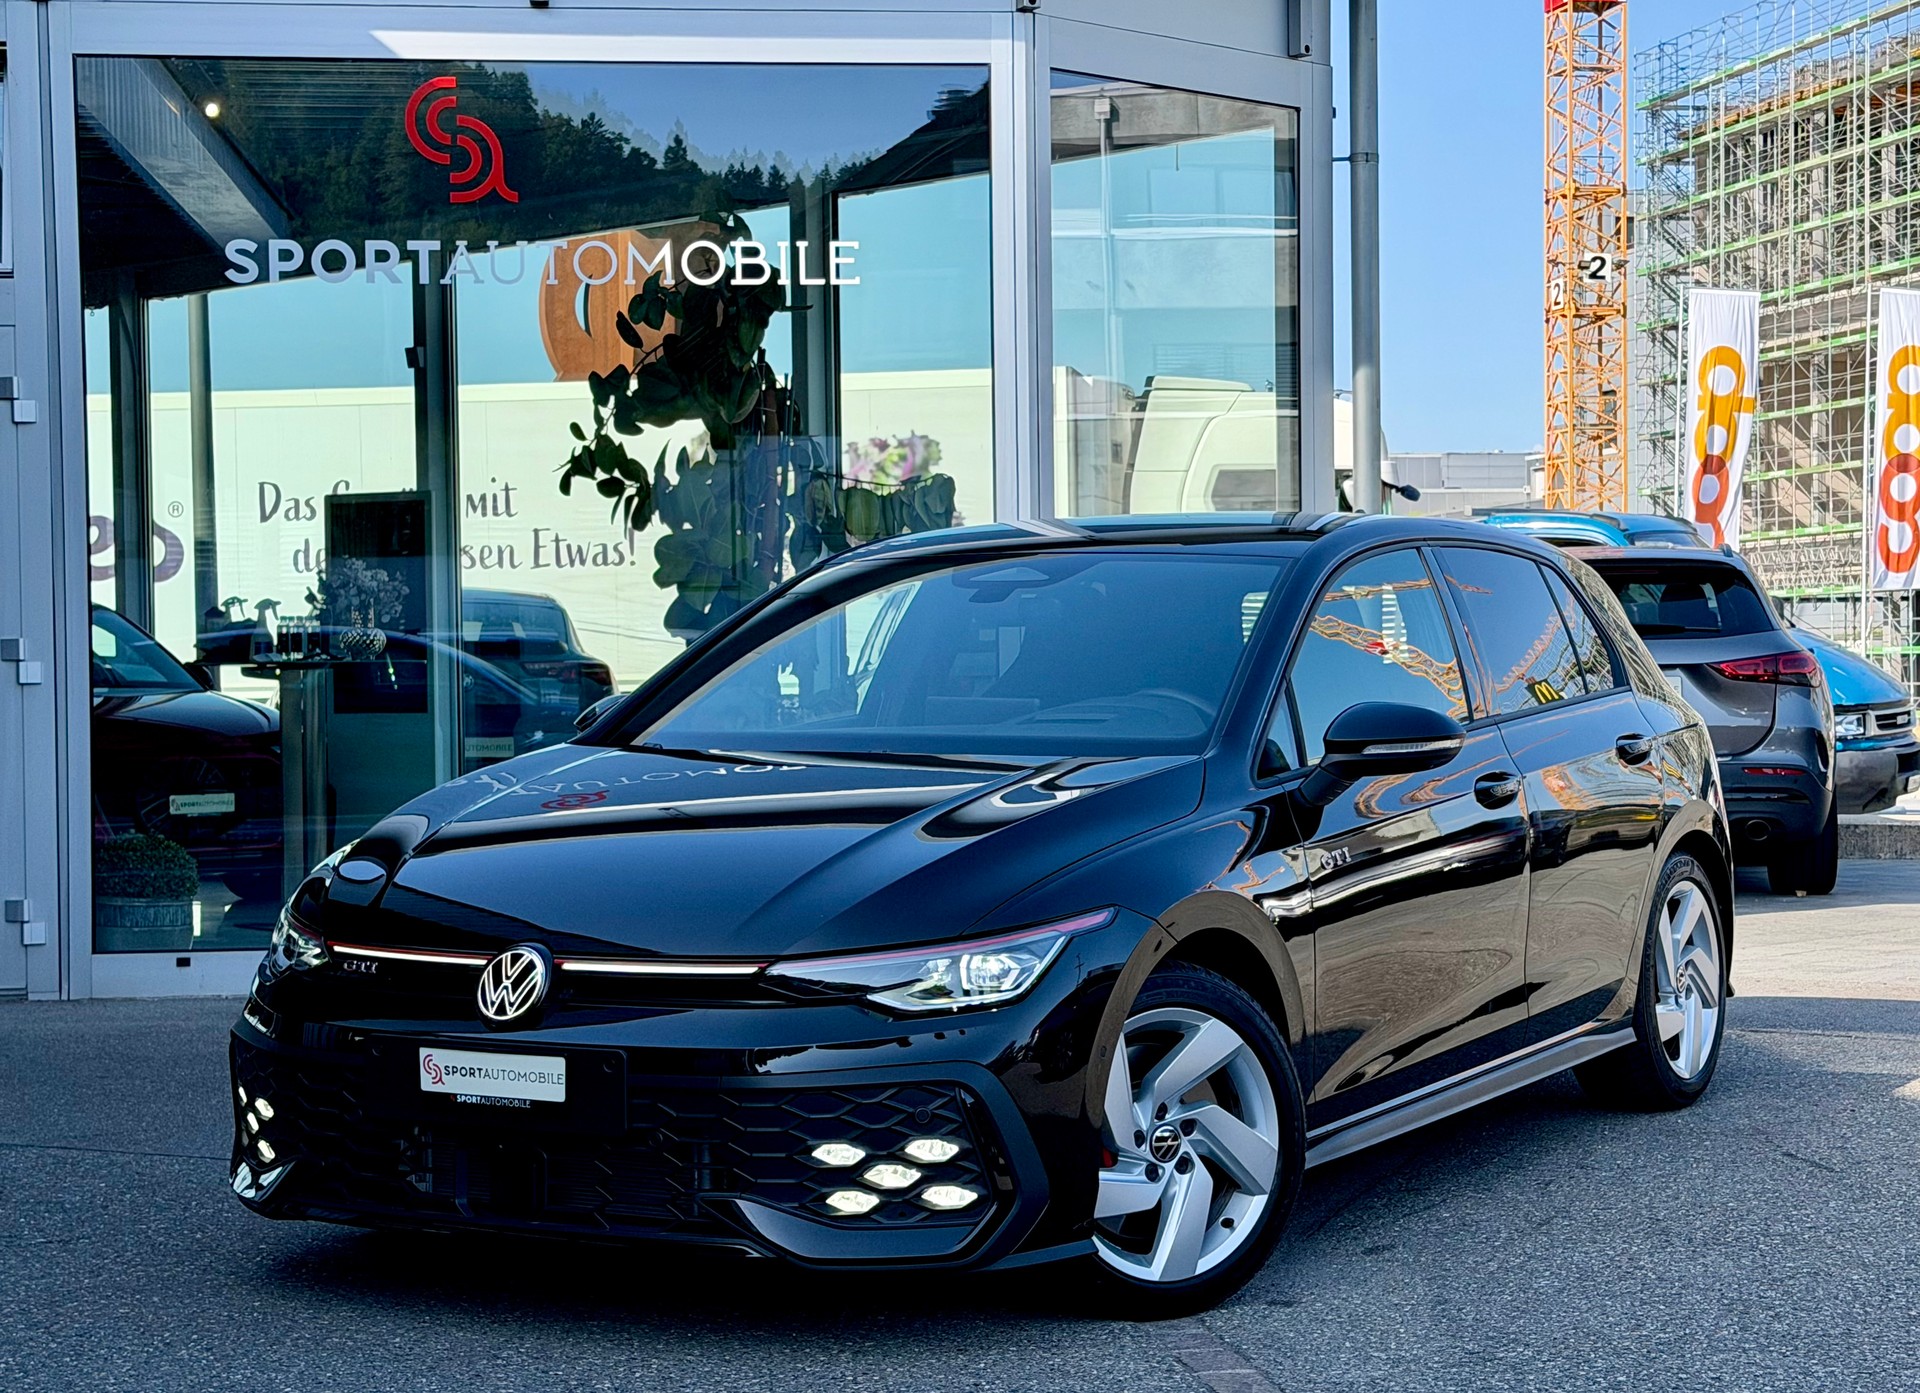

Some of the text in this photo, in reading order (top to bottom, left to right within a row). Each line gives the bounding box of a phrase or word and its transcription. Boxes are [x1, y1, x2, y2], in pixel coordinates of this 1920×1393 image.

[223, 238, 862, 286] SPORTAUTOMOBILE
[1588, 255, 1607, 280] 2
[1553, 282, 1562, 307] 2
[1691, 345, 1758, 549] oop
[257, 481, 318, 524] Das
[529, 527, 636, 570] Etwas!
[1321, 846, 1352, 870] GTI
[343, 960, 379, 974] GTI
[443, 1065, 565, 1086] SPORTAUTOMOBILE
[456, 1094, 531, 1109] SPORTAUTOMOBILE
